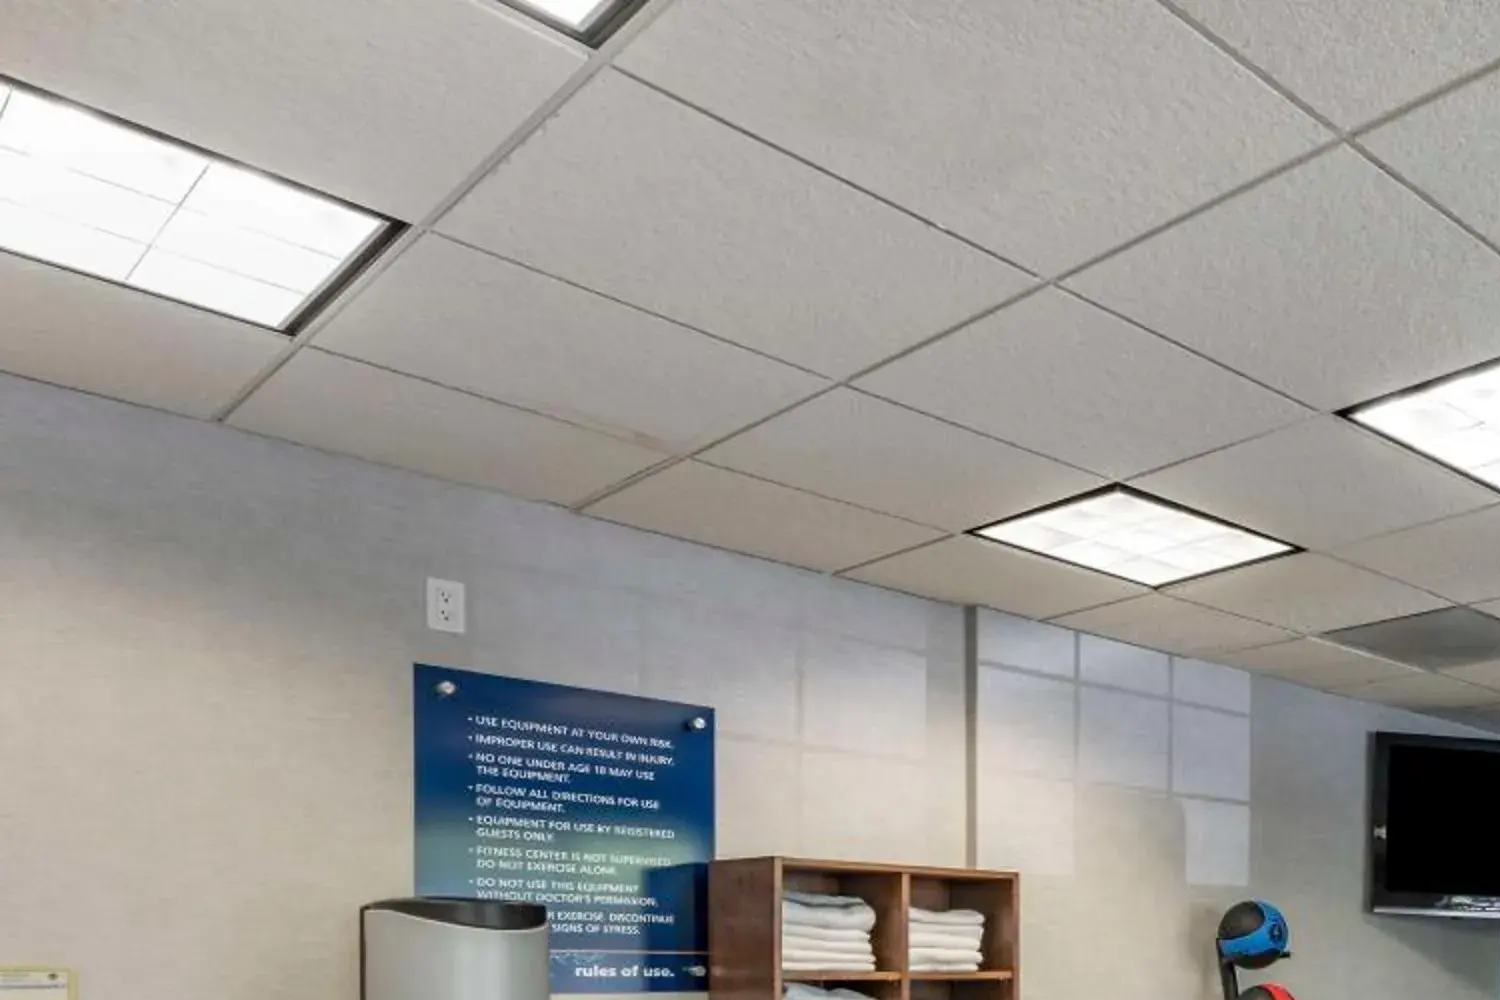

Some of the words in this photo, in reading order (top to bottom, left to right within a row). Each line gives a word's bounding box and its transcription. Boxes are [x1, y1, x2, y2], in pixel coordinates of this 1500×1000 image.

[475, 716, 498, 727] USE
[501, 719, 568, 735] EQUIPMENT
[571, 728, 584, 738] AT
[587, 730, 619, 742] YOUR
[620, 733, 648, 745] OWN
[475, 734, 534, 749] IMPROPER
[537, 741, 557, 753] USE
[560, 744, 584, 755] CAN
[586, 747, 623, 759] RESULT
[625, 752, 636, 761] IN
[475, 753, 495, 763] NO
[497, 754, 523, 766] ONE
[526, 758, 565, 770] UNDER
[567, 763, 590, 774] AGE
[595, 765, 606, 775] 18
[609, 767, 633, 778] MAY
[635, 770, 655, 781] USE
[476, 765, 499, 776] THE
[475, 784, 527, 797] FOLLOW
[529, 789, 548, 799] ALL
[551, 791, 616, 806] DIRECTIONS
[617, 797, 638, 807] FOR
[641, 799, 659, 809] USE
[476, 797, 492, 807] OF
[476, 815, 547, 829] EQUIPMENT
[549, 820, 571, 831] FOR
[573, 823, 595, 833] USE
[597, 824, 611, 834] BY
[476, 827, 520, 840] GUESTS
[476, 845, 522, 858] FITNESS
[525, 849, 568, 861] CENTER
[571, 852, 580, 862] IS
[583, 853, 607, 863] NOT
[476, 858, 496, 869] DO
[499, 860, 524, 870] NOT
[527, 861, 577, 873] EXERCISE
[476, 877, 496, 887] DO
[498, 878, 524, 888] NOT
[526, 879, 547, 889] USE
[551, 880, 574, 891] THIS
[577, 881, 639, 893] EQUIPMENT
[476, 889, 533, 901] WITHOUT
[609, 913, 674, 925] DISCONTINUE
[552, 923, 583, 933] SIGNS
[585, 924, 600, 933] OF
[575, 965, 617, 977] rules
[621, 964, 639, 977] of
[643, 967, 675, 977] use.
